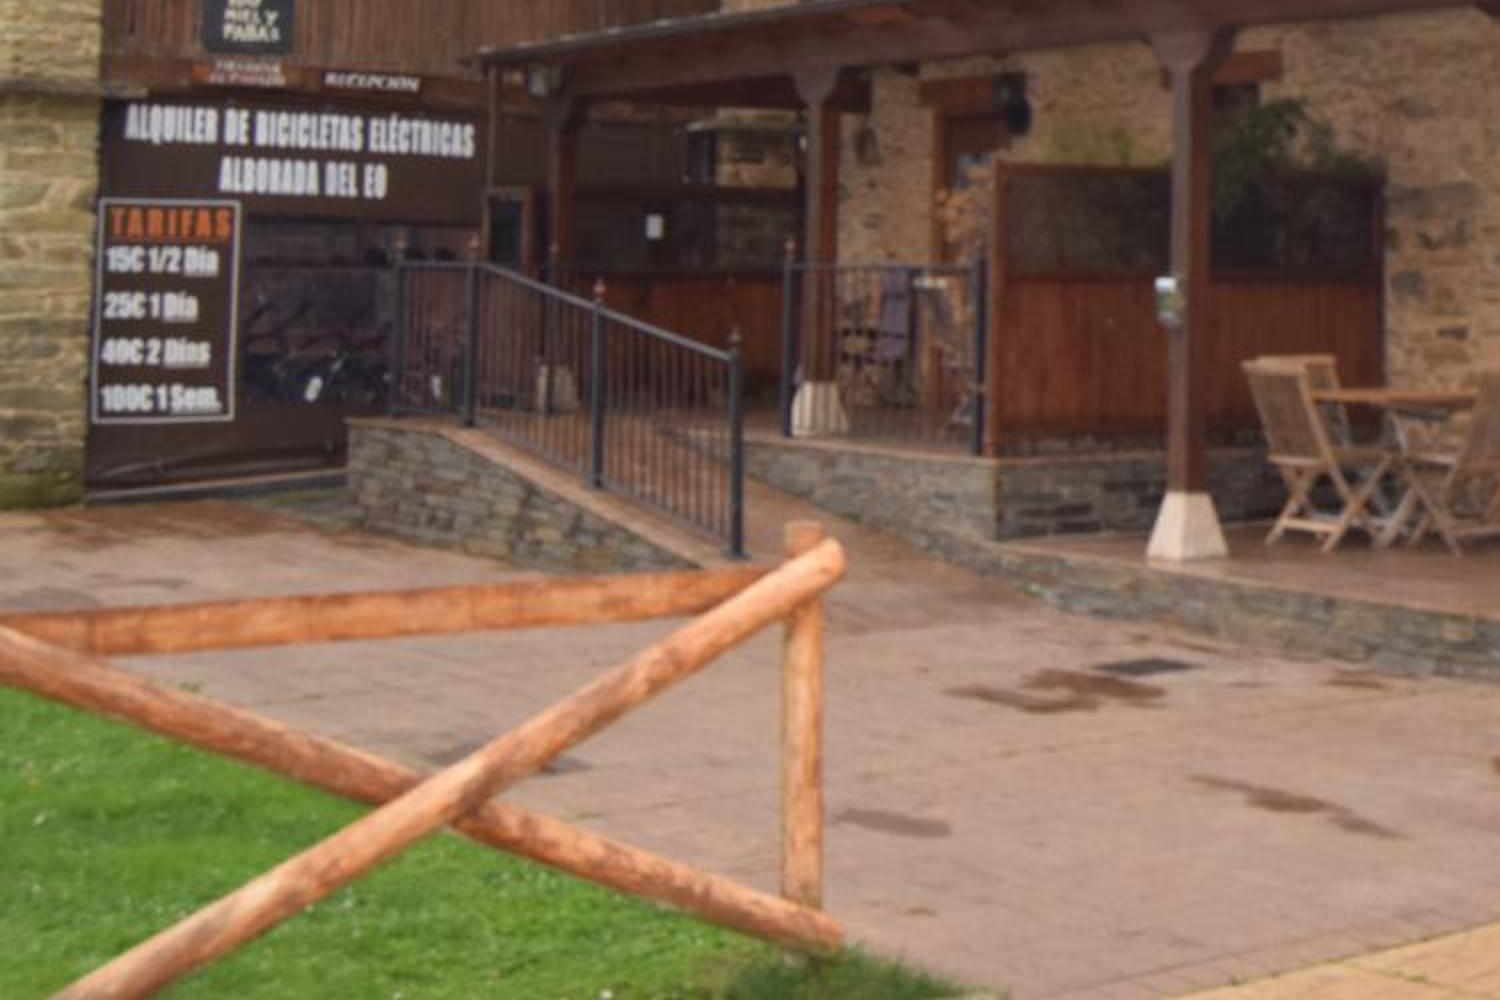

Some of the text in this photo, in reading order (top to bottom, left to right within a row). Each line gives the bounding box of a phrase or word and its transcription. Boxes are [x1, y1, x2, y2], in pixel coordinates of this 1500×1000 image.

[263, 9, 280, 25] Y
[124, 103, 476, 158] ALQUILER DE BICICLETAS ELÉCTRICAS
[219, 155, 388, 199] ALBORADA DEL EO
[111, 206, 231, 239] TARIFAS
[148, 245, 181, 273] 1/2
[149, 291, 160, 318] 1
[146, 337, 161, 364] 2
[157, 384, 168, 412] 1
